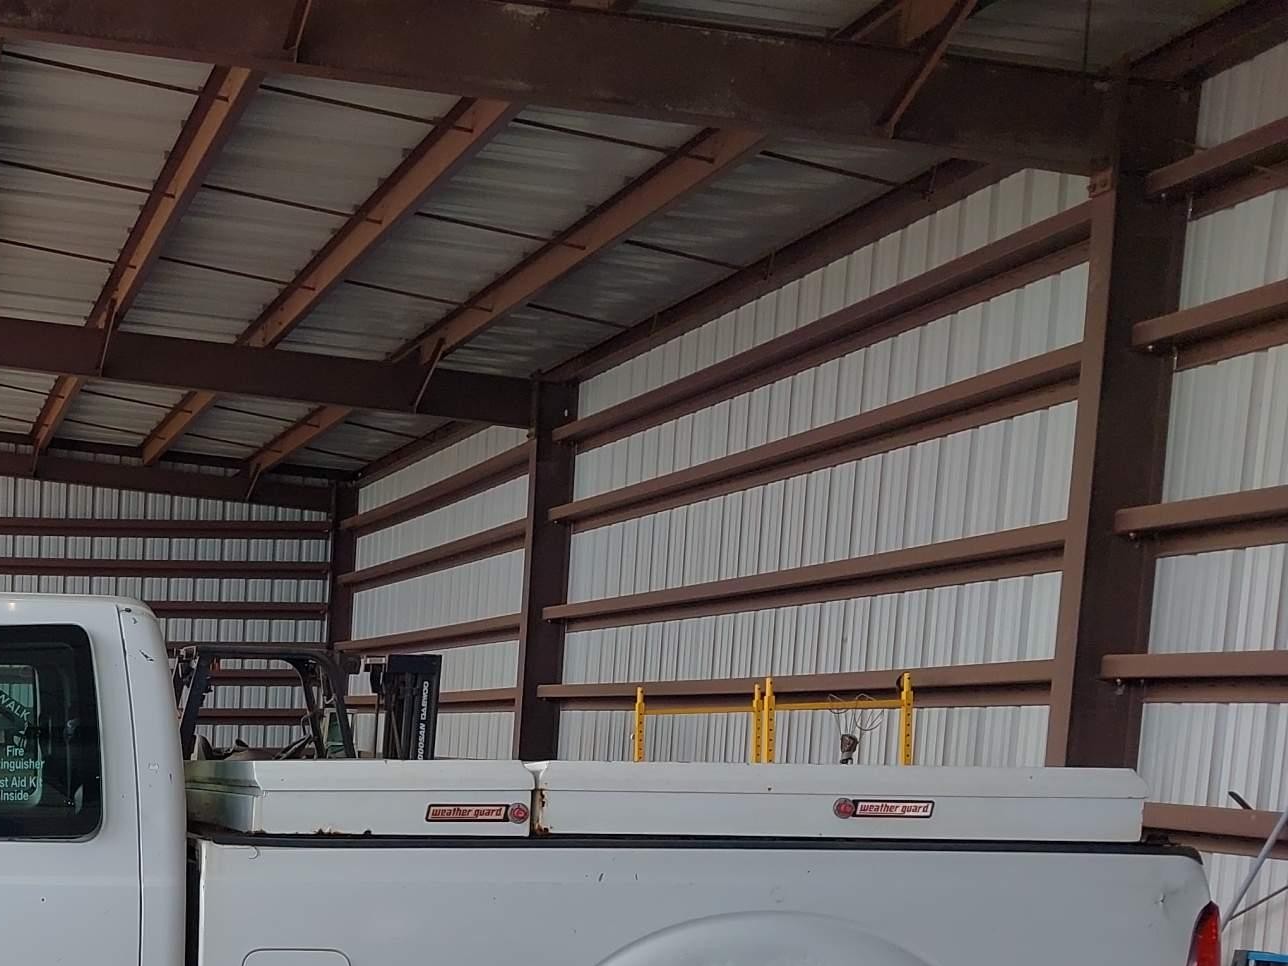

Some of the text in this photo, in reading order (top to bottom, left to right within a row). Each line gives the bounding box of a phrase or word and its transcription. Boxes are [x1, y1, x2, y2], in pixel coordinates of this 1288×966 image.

[6, 745, 25, 756] Fire
[11, 776, 27, 788] Aid
[0, 789, 29, 801] Inside
[431, 807, 503, 818] weather guard
[859, 803, 930, 814] weather guard
